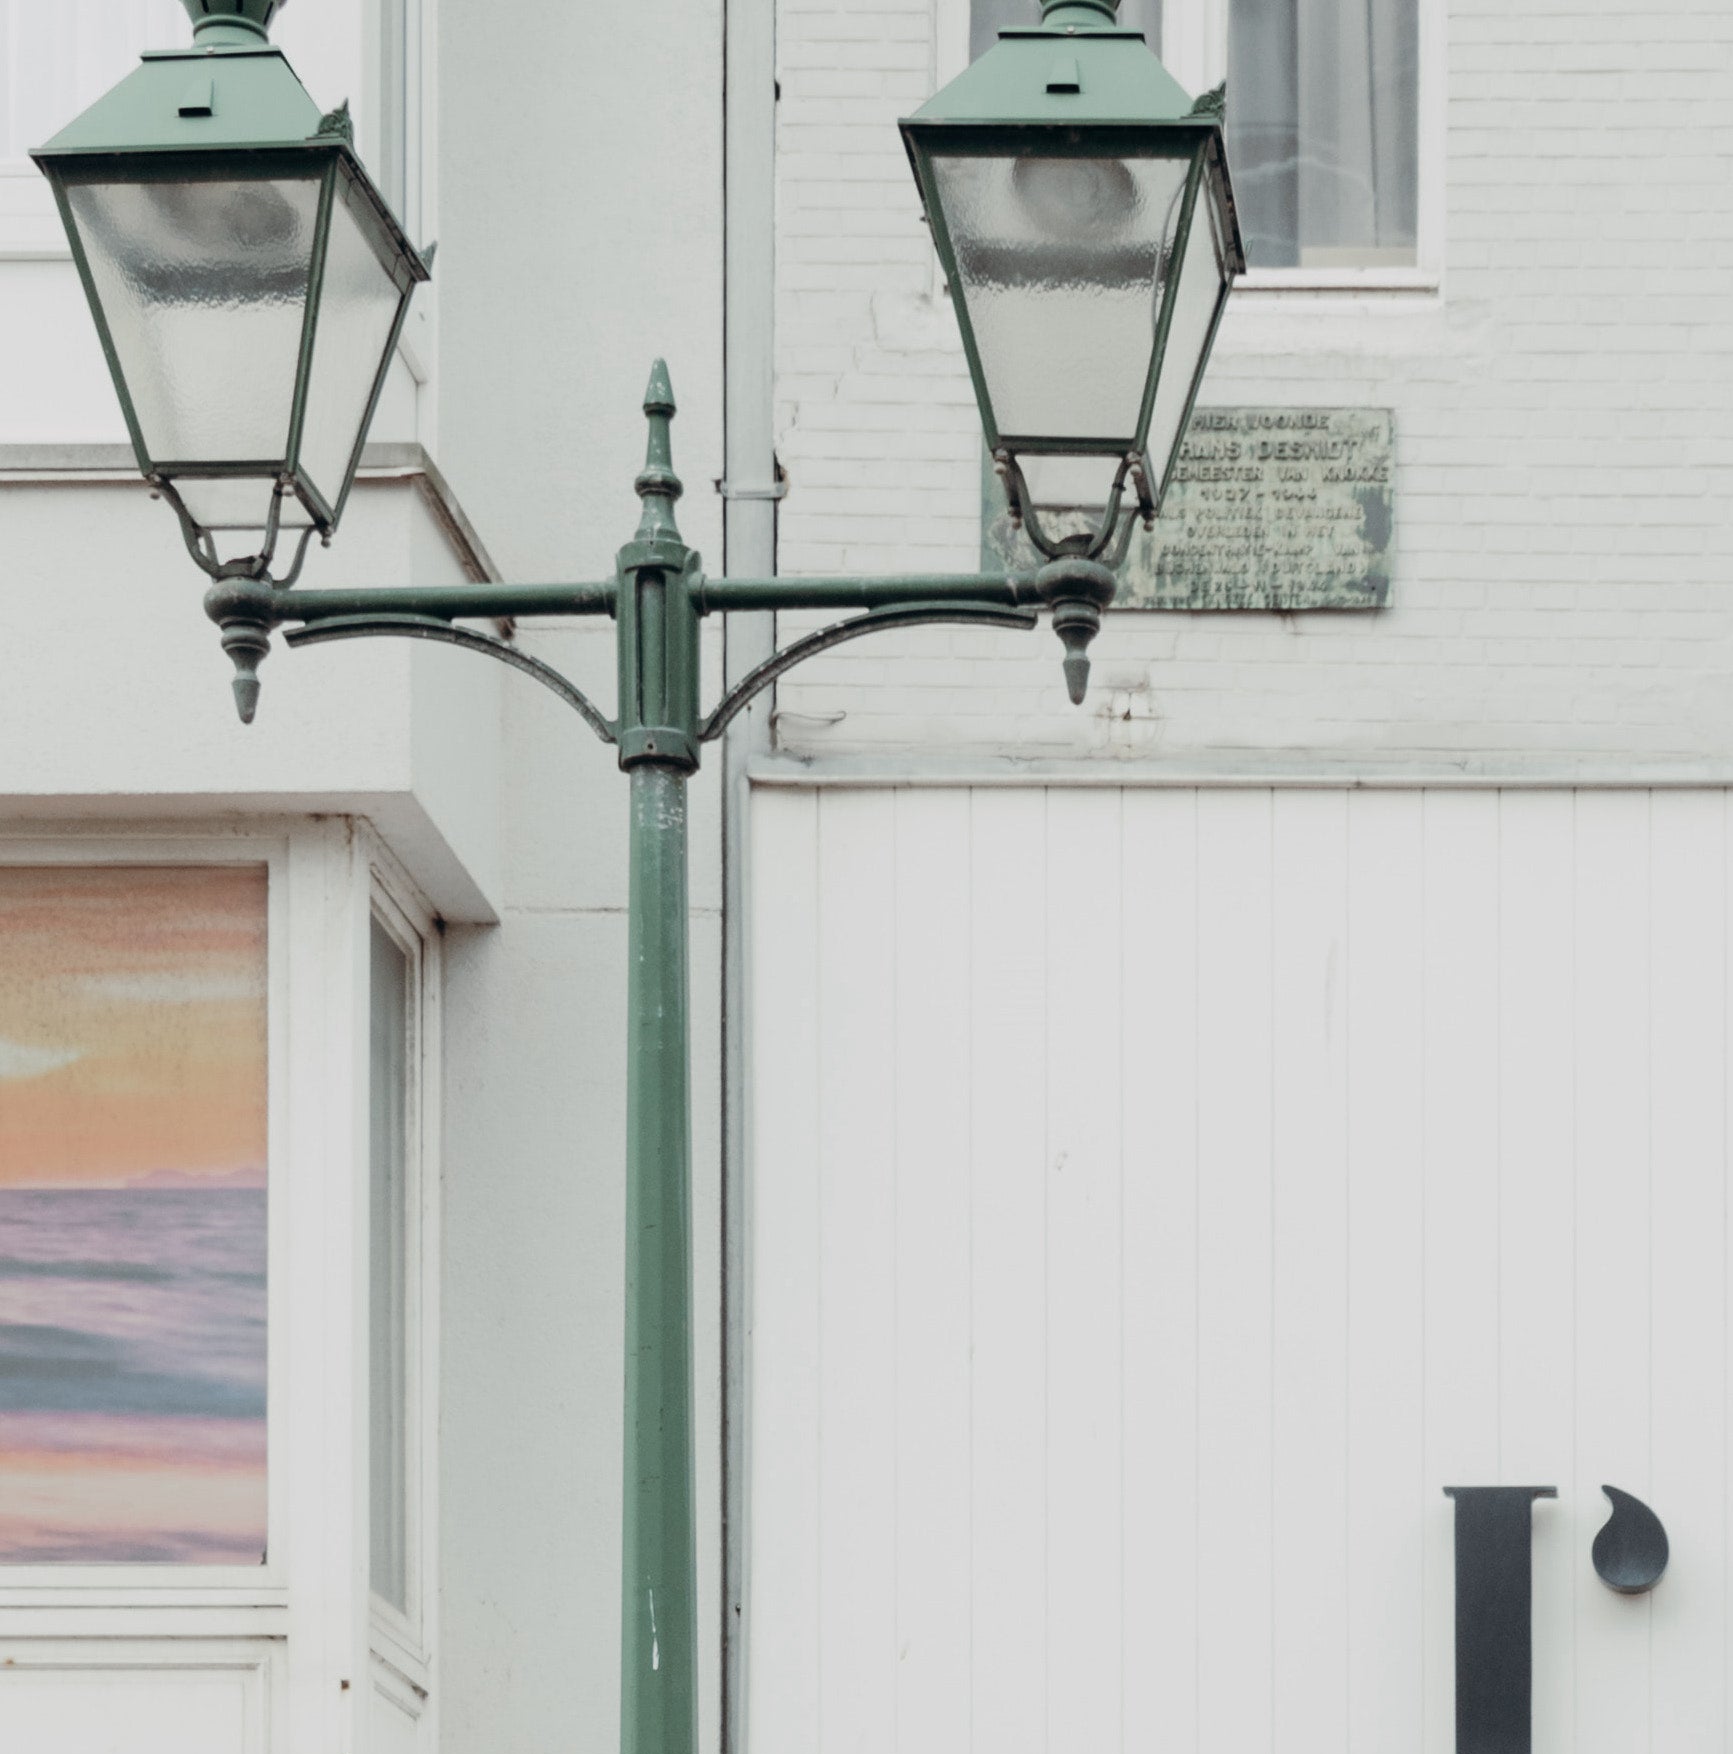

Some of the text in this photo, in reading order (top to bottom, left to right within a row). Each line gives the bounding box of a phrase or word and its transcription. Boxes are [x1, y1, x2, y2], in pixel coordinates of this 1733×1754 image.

[1245, 414, 1331, 431] WOONDE
[1179, 441, 1242, 461] RANS
[1279, 467, 1308, 482] VAN
[1322, 466, 1390, 483] KNOKKE
